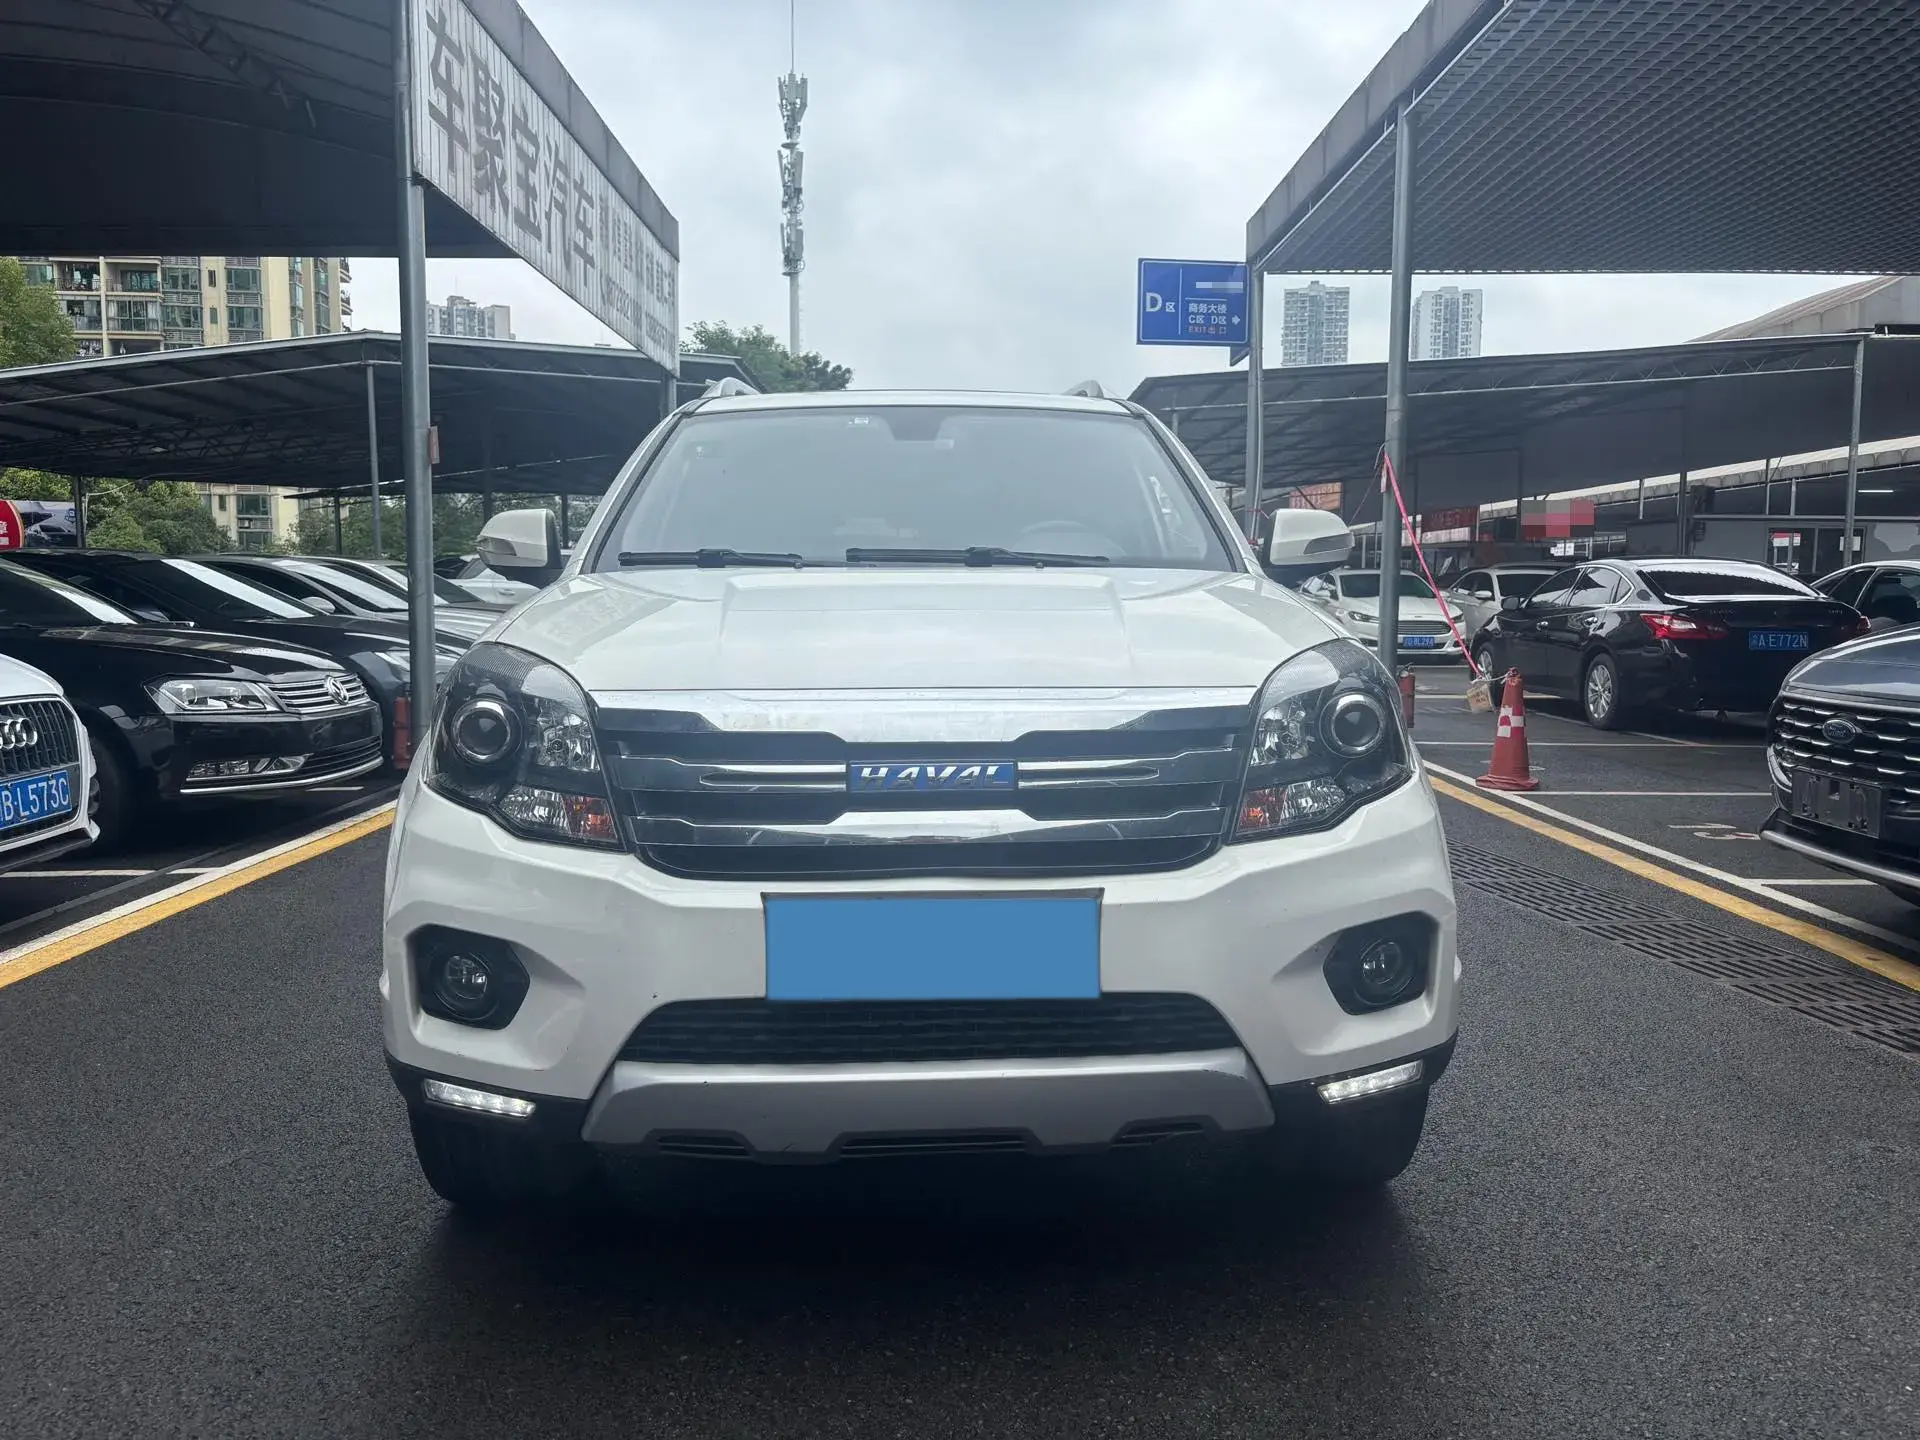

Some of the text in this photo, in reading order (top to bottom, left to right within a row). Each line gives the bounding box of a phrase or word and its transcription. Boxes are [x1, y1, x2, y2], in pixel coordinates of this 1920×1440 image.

[426, 6, 596, 288] 车聚宝汽车
[1189, 303, 1227, 314] 商务大楼
[860, 765, 1009, 789] HAVAL
[0, 777, 69, 821] B·L573C
